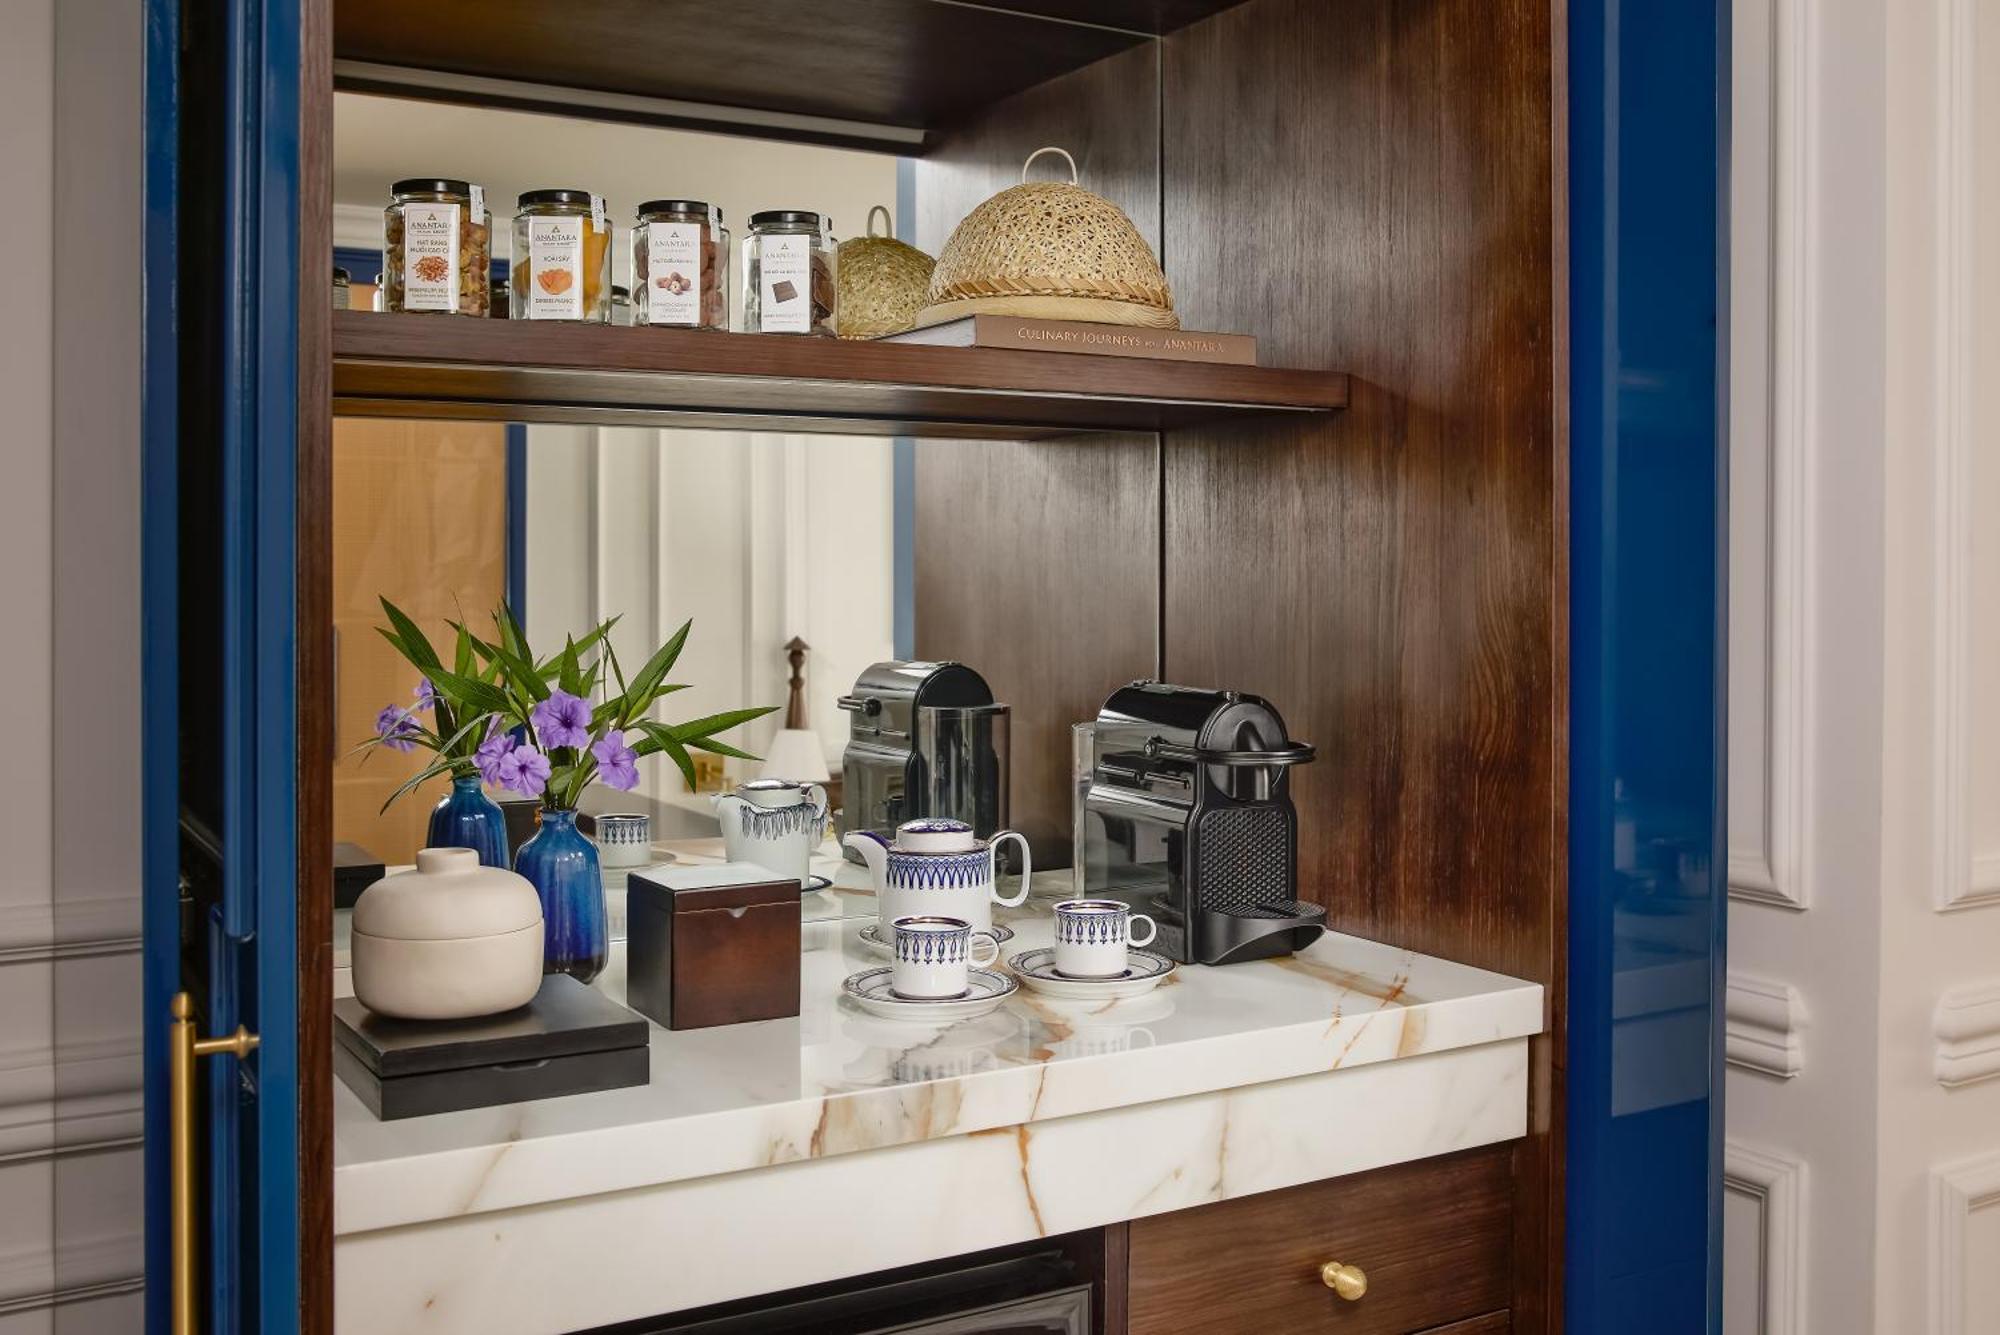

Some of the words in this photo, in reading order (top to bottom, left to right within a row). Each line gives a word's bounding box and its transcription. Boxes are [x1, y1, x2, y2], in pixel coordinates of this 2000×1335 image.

[654, 240, 692, 248] ANANTAR
[1018, 327, 1080, 342] CULINARY
[1082, 330, 1141, 347] JOURNEYS
[1164, 338, 1224, 353] ANANTARA
